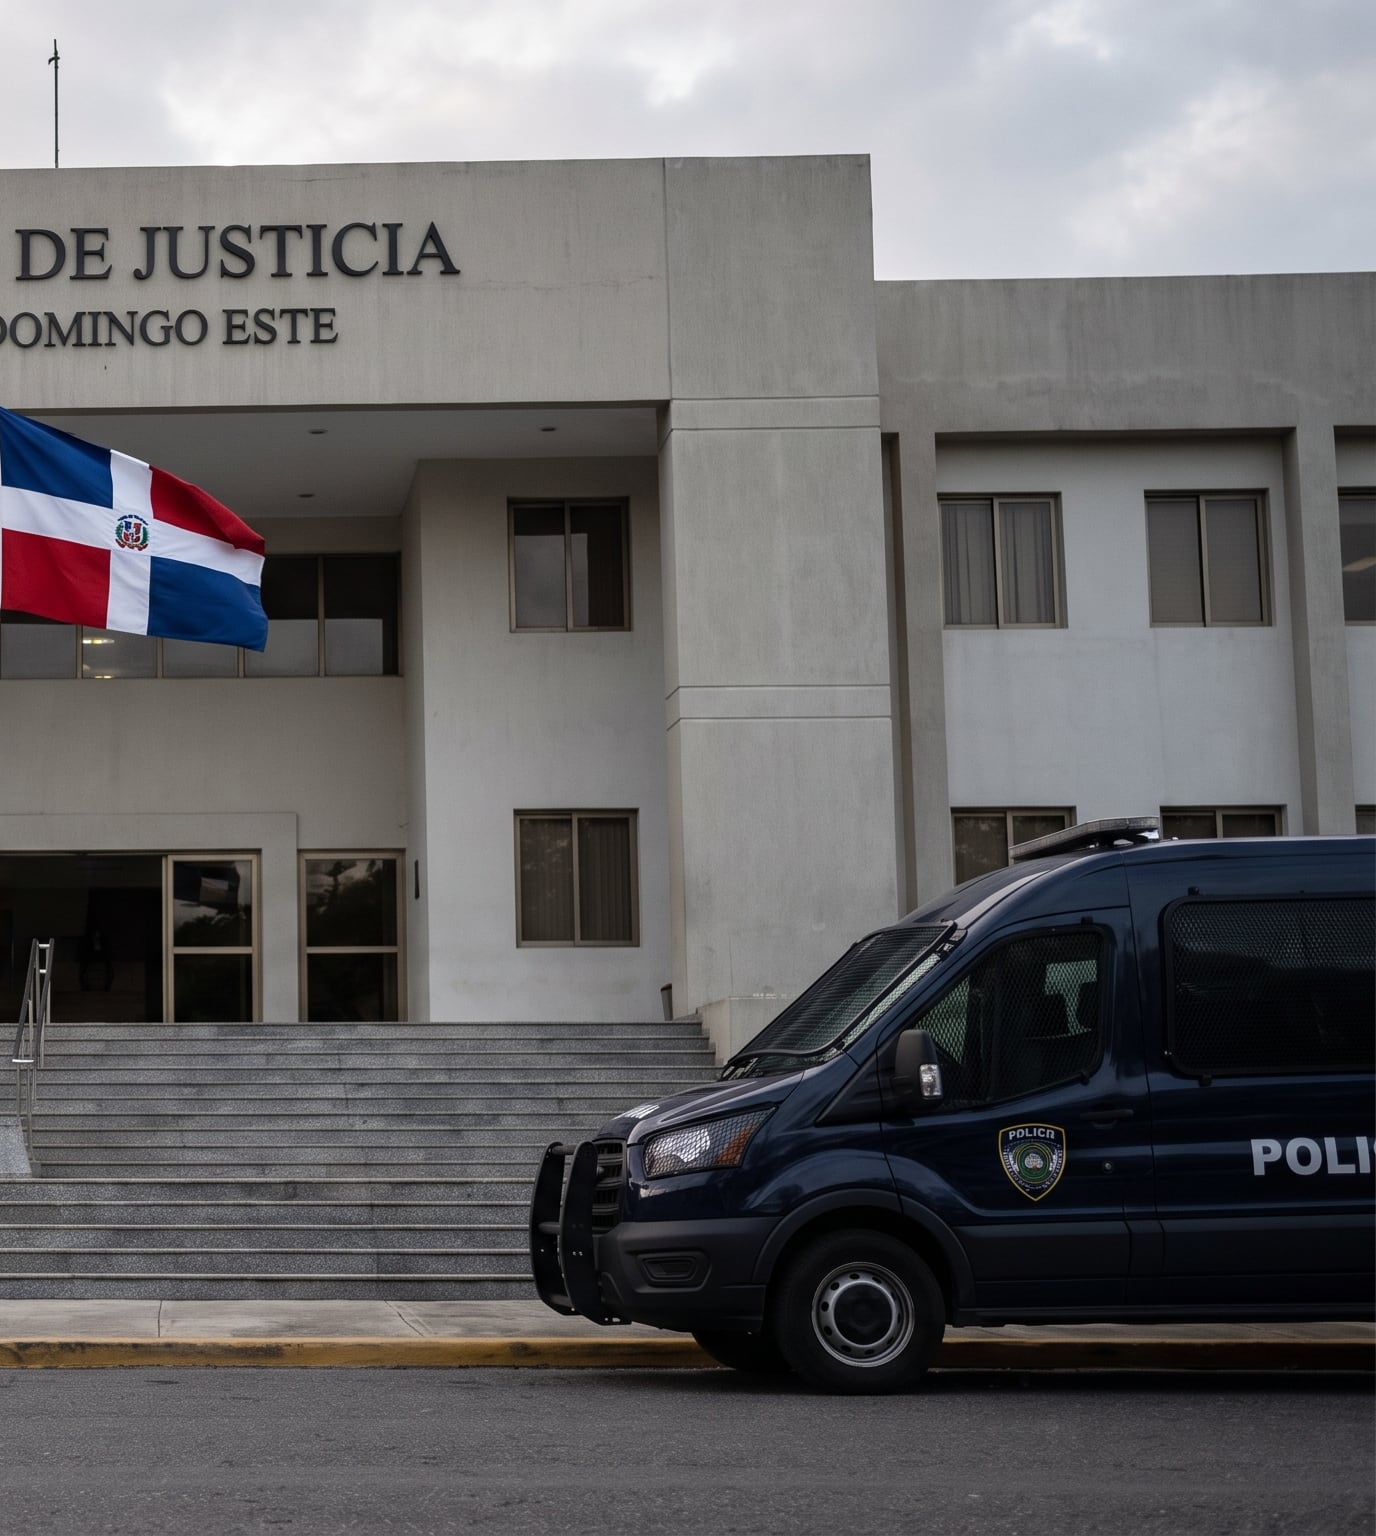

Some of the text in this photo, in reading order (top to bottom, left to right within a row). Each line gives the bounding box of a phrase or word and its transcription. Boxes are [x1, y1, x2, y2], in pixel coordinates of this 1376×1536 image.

[15, 227, 112, 281] DE
[133, 222, 461, 281] JUSTICIA
[222, 308, 339, 346] ESTE
[1250, 1136, 1376, 1176] POLI
